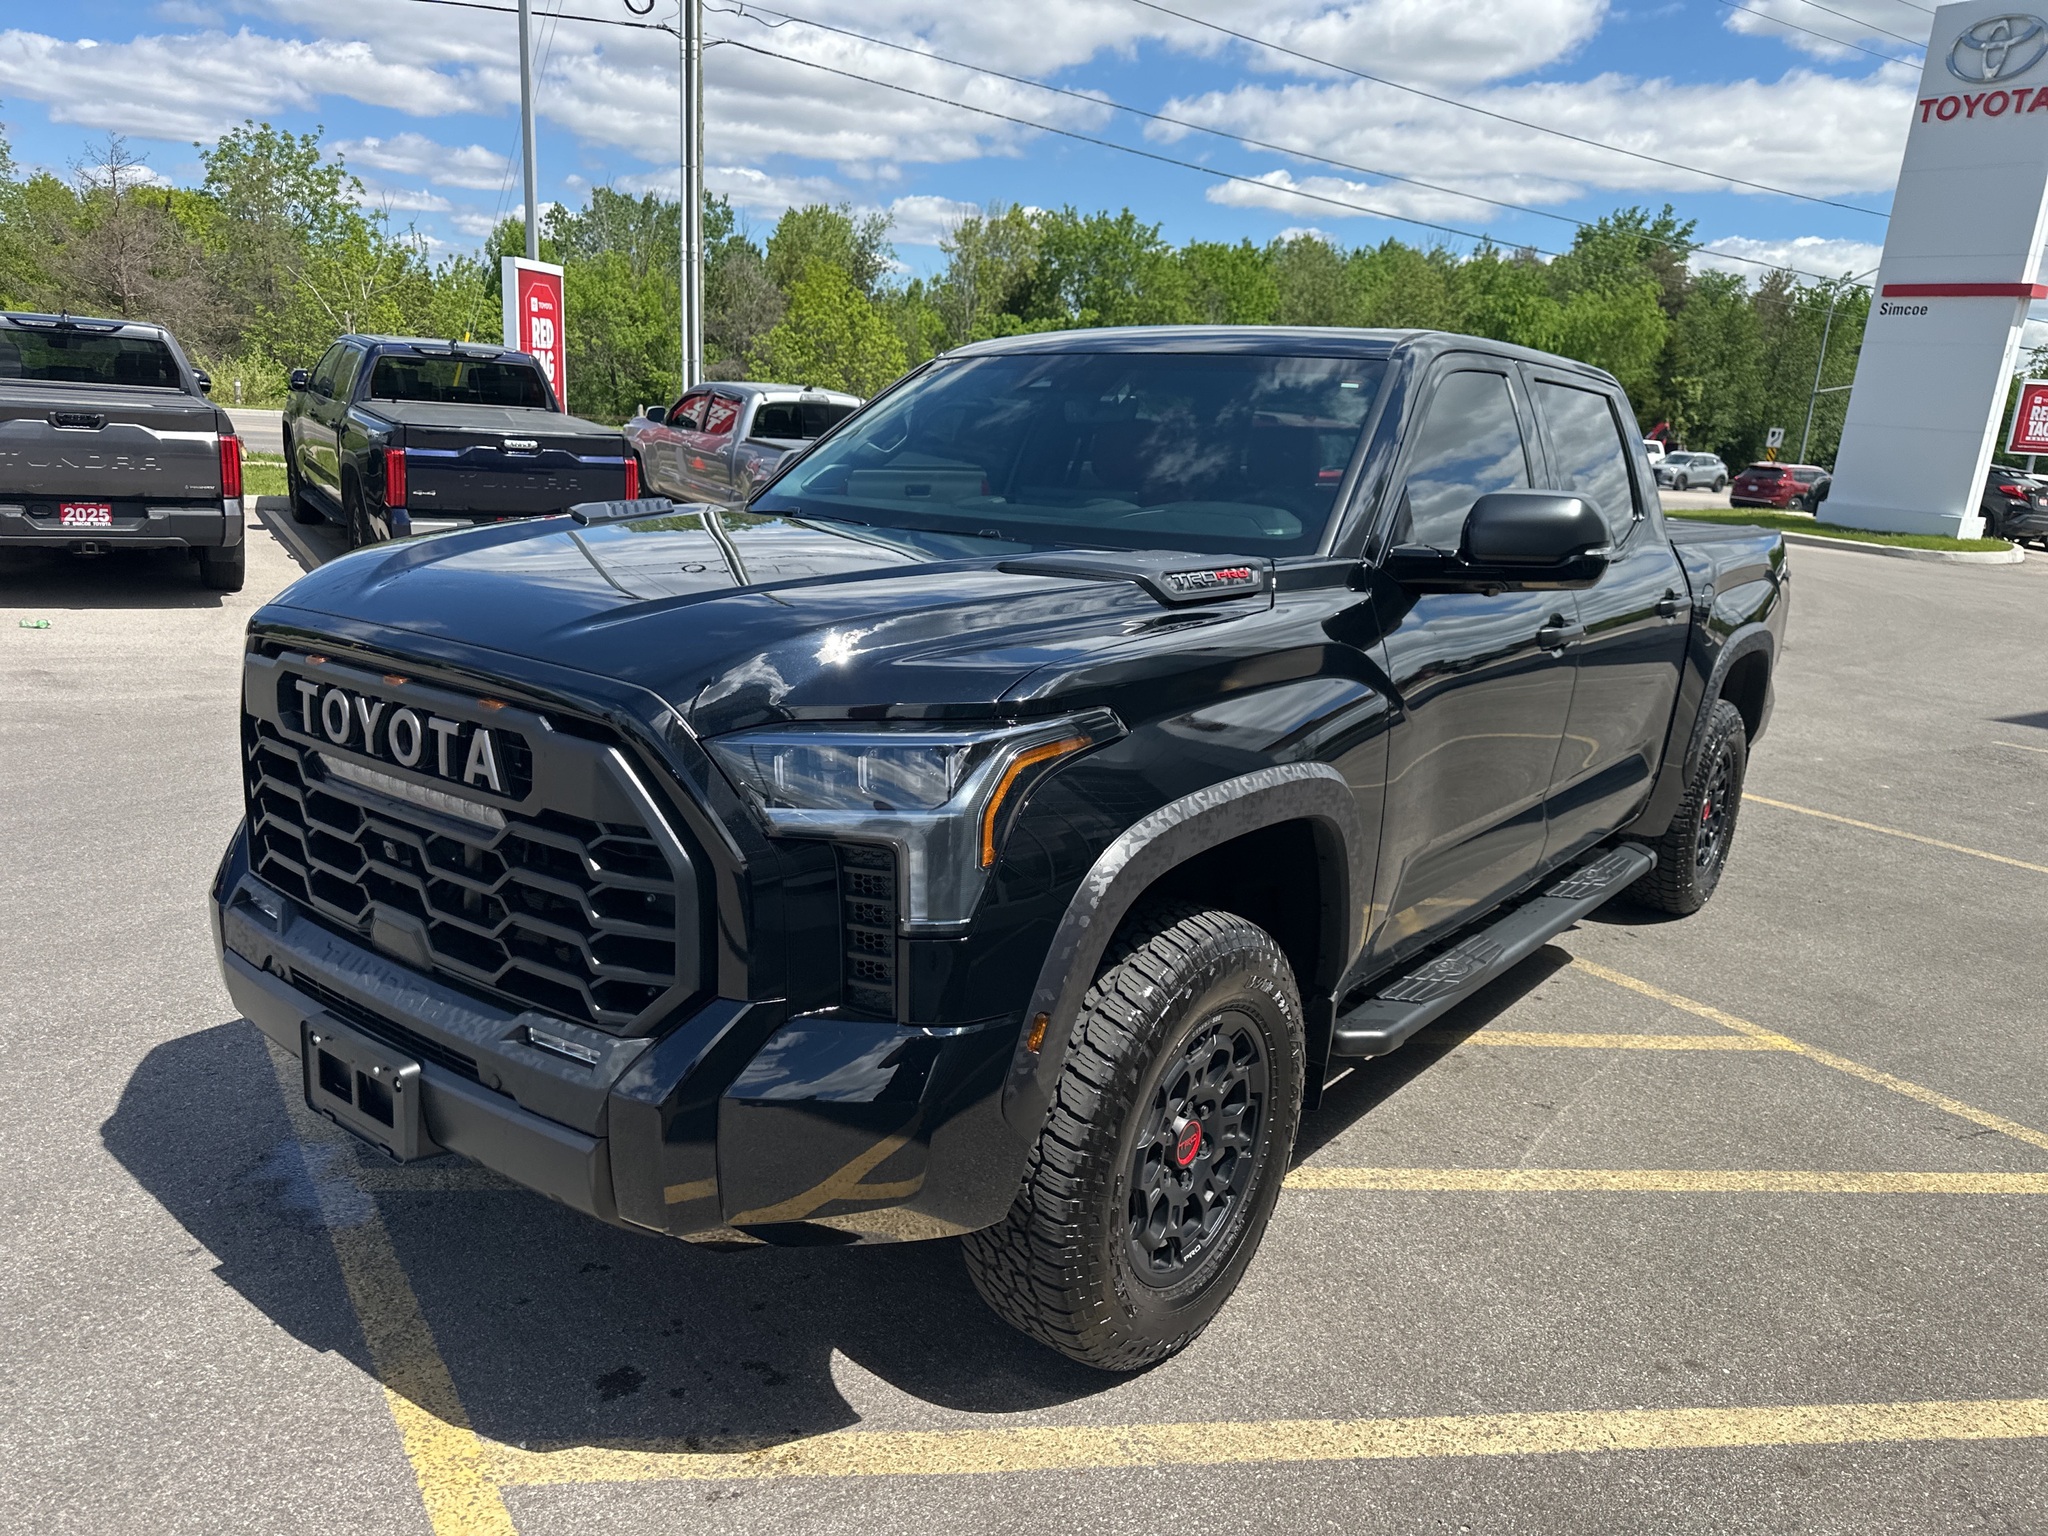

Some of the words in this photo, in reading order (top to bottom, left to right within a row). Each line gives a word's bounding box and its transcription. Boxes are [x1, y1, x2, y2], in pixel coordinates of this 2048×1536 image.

[1920, 87, 2048, 122] TOYOTA
[1880, 302, 1928, 315] Simcoe
[531, 317, 554, 349] RED
[2030, 405, 2048, 421] RE
[63, 507, 110, 522] 2025
[1172, 571, 1218, 588] TRD
[1216, 568, 1249, 581] PRO
[296, 679, 504, 792] TOYOTA
[1183, 1244, 1202, 1262] PRO
